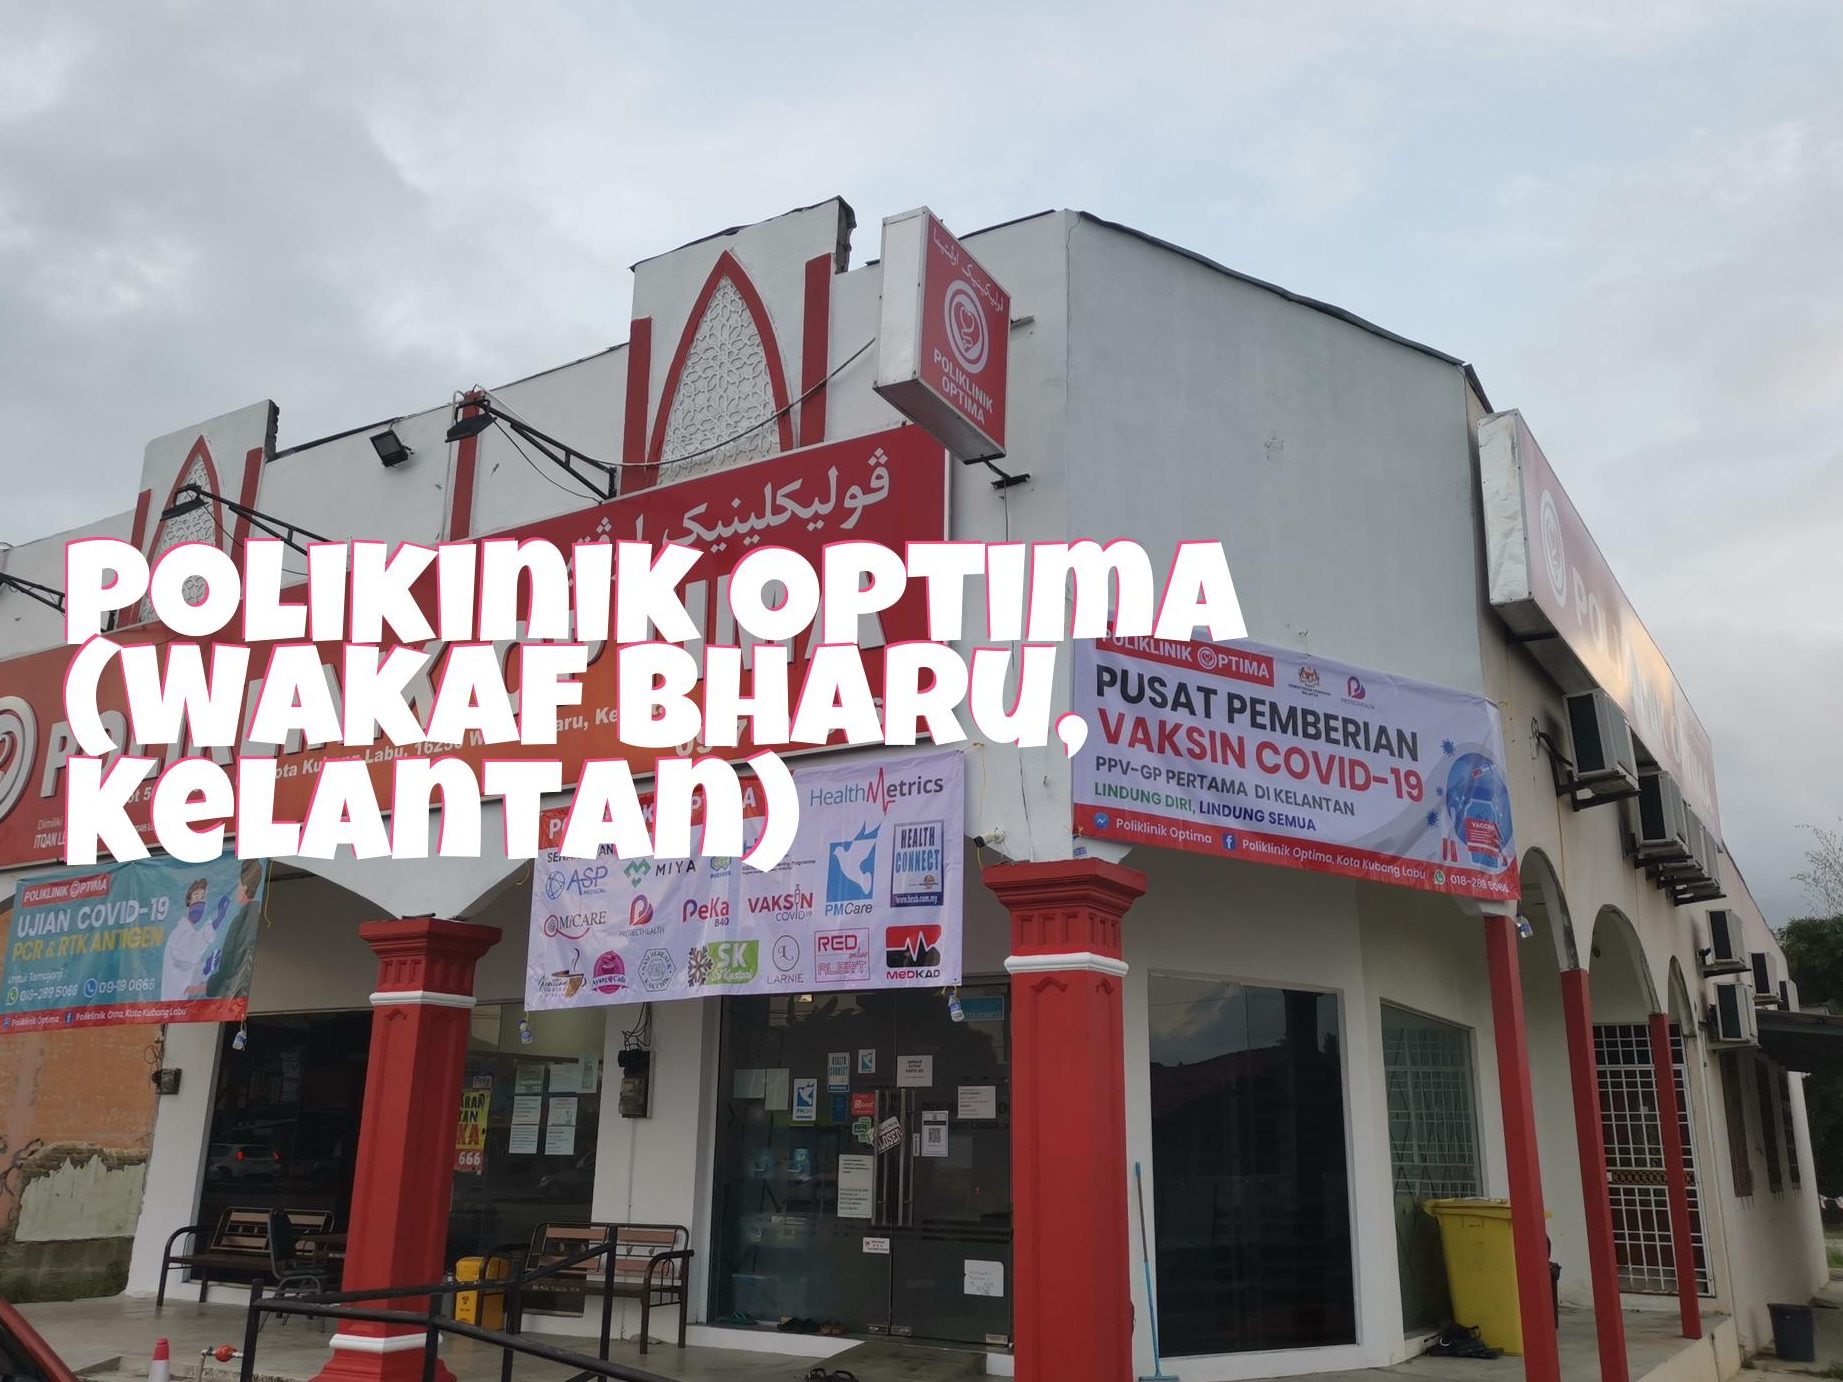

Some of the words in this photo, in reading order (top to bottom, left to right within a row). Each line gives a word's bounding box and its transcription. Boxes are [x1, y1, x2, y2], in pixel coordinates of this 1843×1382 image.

[933, 347, 993, 414] POLIKLINIK
[941, 378, 986, 426] OPTIMA
[1096, 663, 1217, 718] PUSAT
[1228, 697, 1419, 762] PEMBERIAN
[1097, 707, 1246, 769] VAKSIN
[1255, 740, 1424, 802] COVID-19
[1095, 755, 1162, 781] PPV-GP
[1166, 769, 1248, 797] PERTAMA
[1255, 783, 1271, 801] DI
[1273, 785, 1355, 817] KELANTAN
[1094, 783, 1162, 807] LINDUNG
[1166, 793, 1196, 815] DIRI,
[1199, 801, 1265, 823] LINDUNG
[1268, 812, 1317, 832] SEMUA
[901, 826, 935, 849] HEALTH
[1116, 817, 1168, 838] Poliklinik
[1169, 828, 1212, 845] Optima
[655, 859, 697, 877] MIYA
[896, 849, 940, 873] CONNECT
[1242, 839, 1291, 858] Poliklinik
[1293, 846, 1334, 865] Optima,
[1336, 854, 1360, 870] Kota
[1362, 858, 1401, 878] Kubang
[1402, 865, 1426, 881] Labu
[25, 885, 68, 901] POLIKLINIK
[566, 865, 609, 896] ASP
[683, 896, 730, 923] PeKa
[748, 887, 813, 914] VAKSIN
[825, 902, 873, 917] PMCare
[17, 908, 71, 938] UJIAN
[77, 896, 170, 928] COVID-19
[12, 941, 42, 962] PCR
[59, 937, 88, 957] RTK
[718, 941, 747, 969] SK
[767, 973, 804, 985] LARNIE
[817, 960, 868, 975] ALERT
